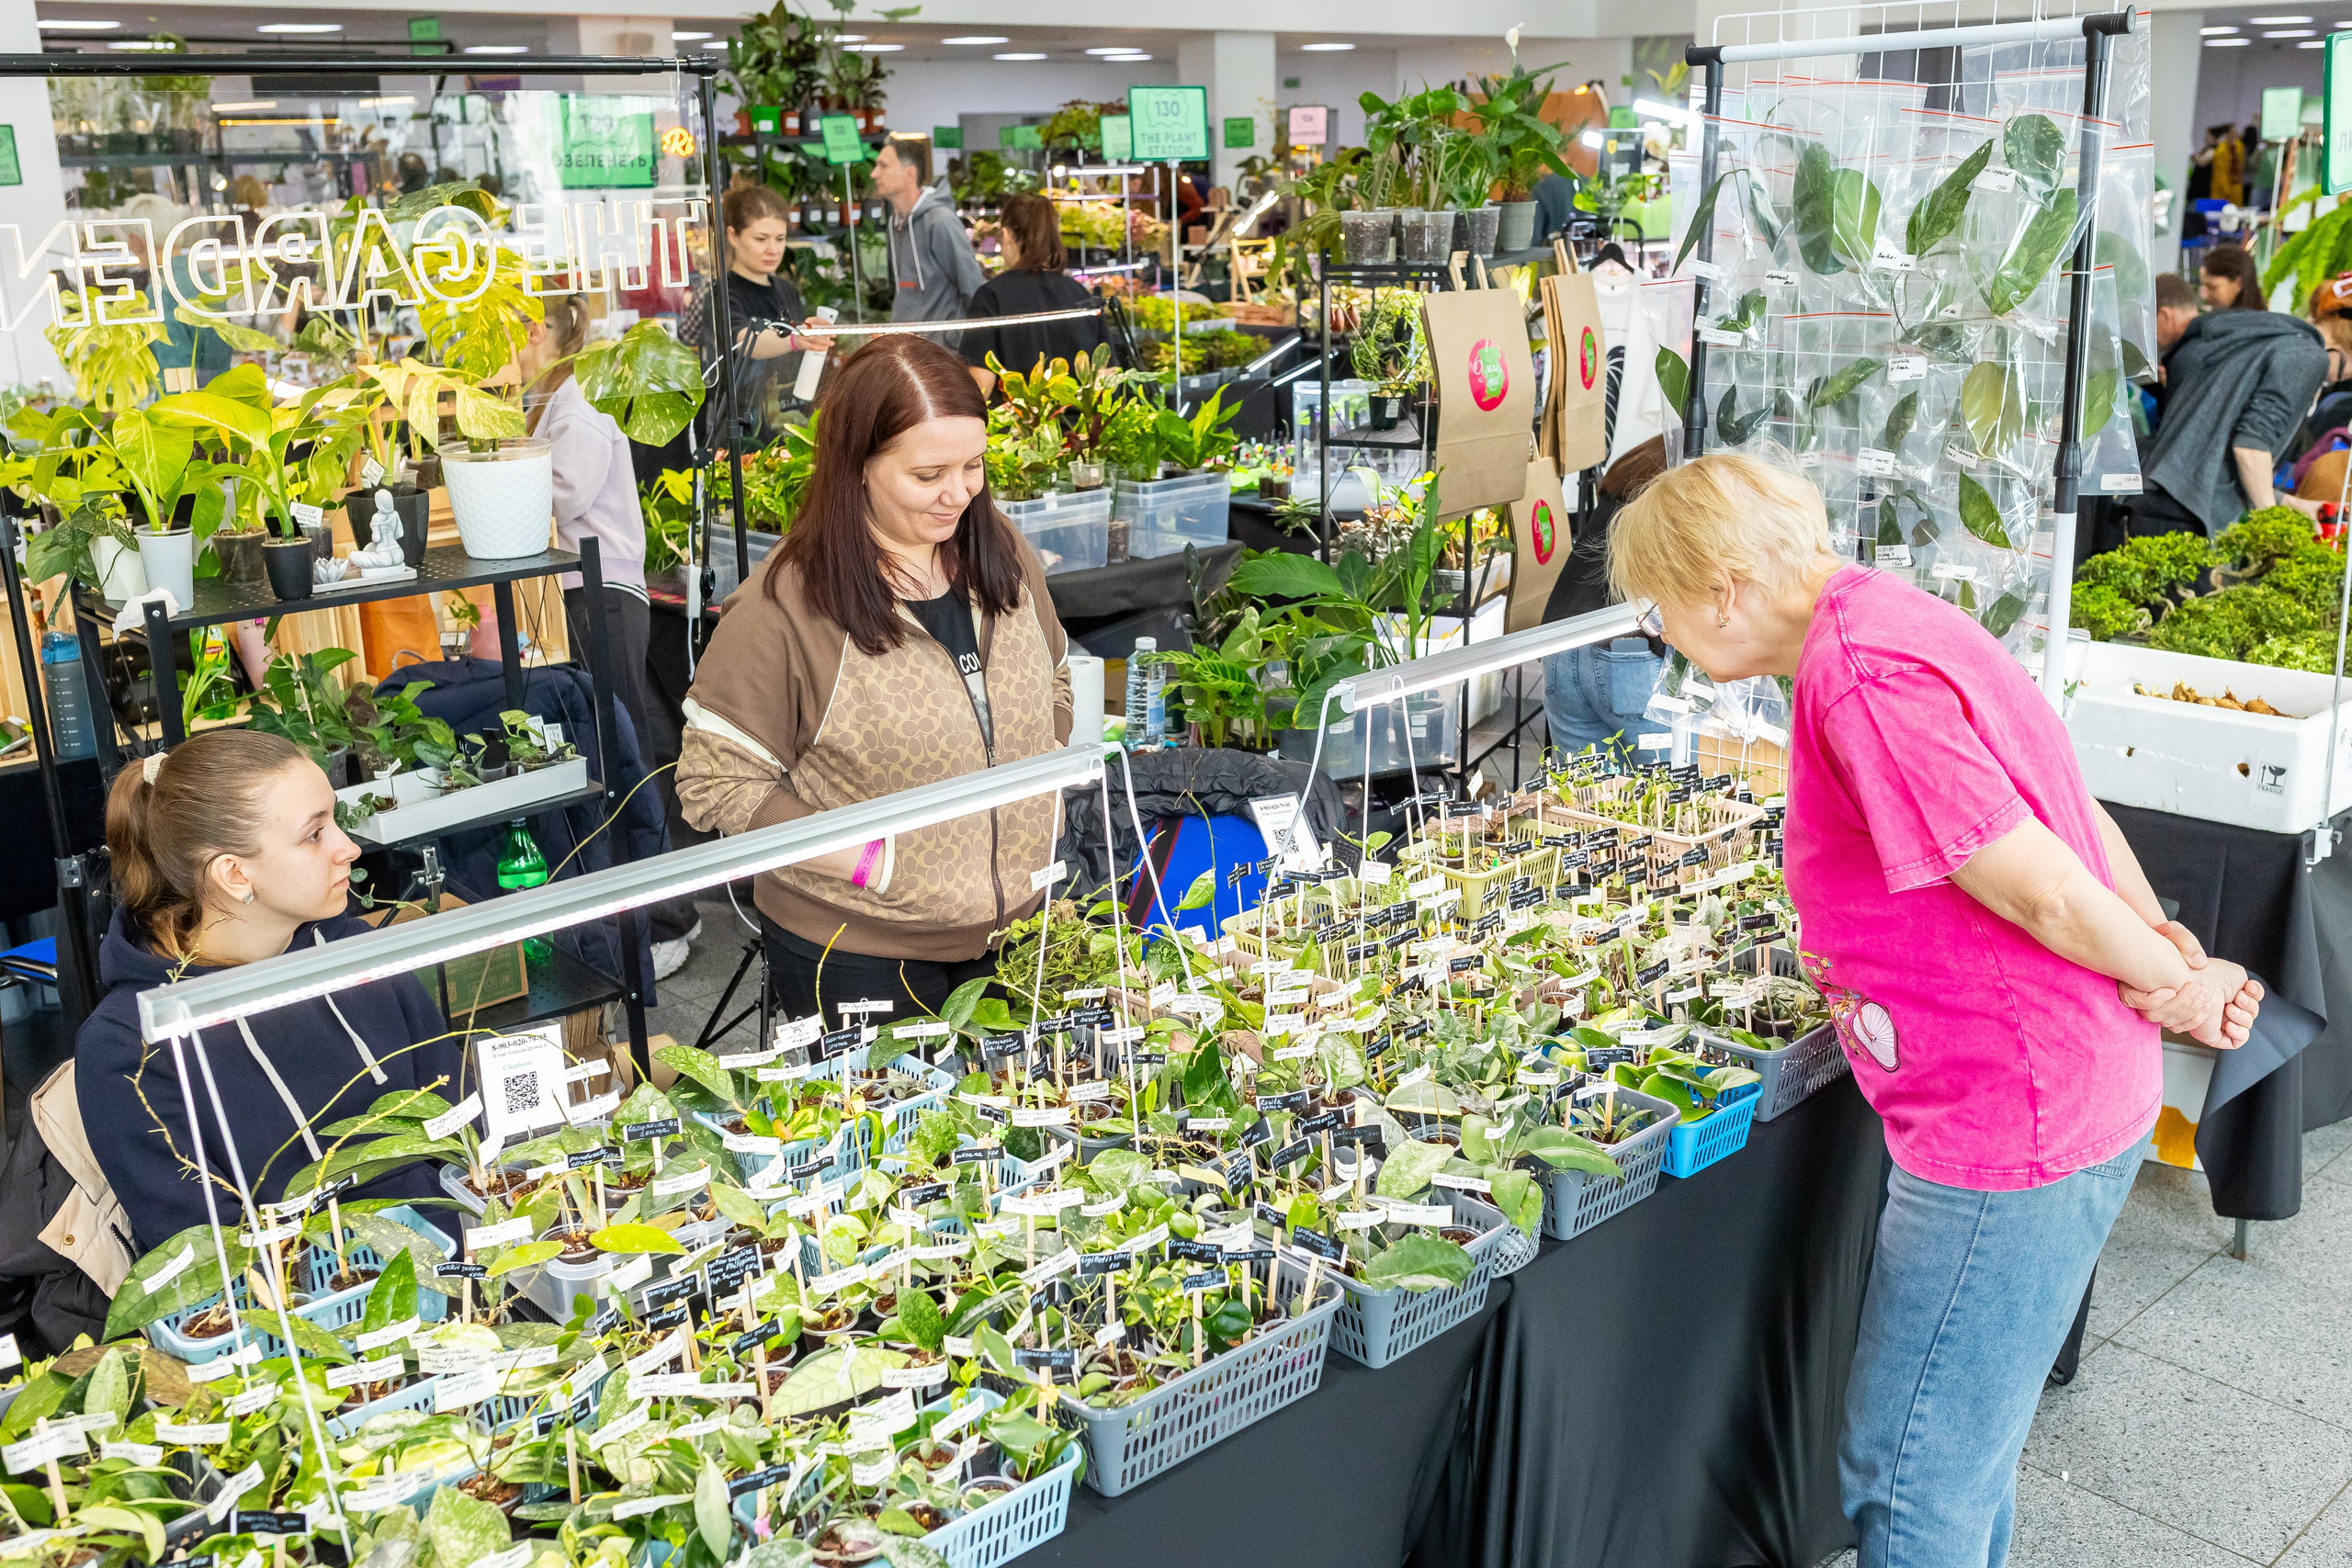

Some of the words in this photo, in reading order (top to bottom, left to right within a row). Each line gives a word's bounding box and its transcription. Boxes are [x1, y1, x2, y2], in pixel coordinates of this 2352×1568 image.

[1154, 100, 1181, 118] 130
[1141, 132, 1160, 143] THE
[1164, 131, 1198, 144] PLANT
[1148, 144, 1193, 156] STATION
[552, 152, 648, 169] ОЗЕЛЕНЕТЬ
[492, 1032, 548, 1052] 8-903-020-79-95
[492, 1051, 507, 1059] Юлия
